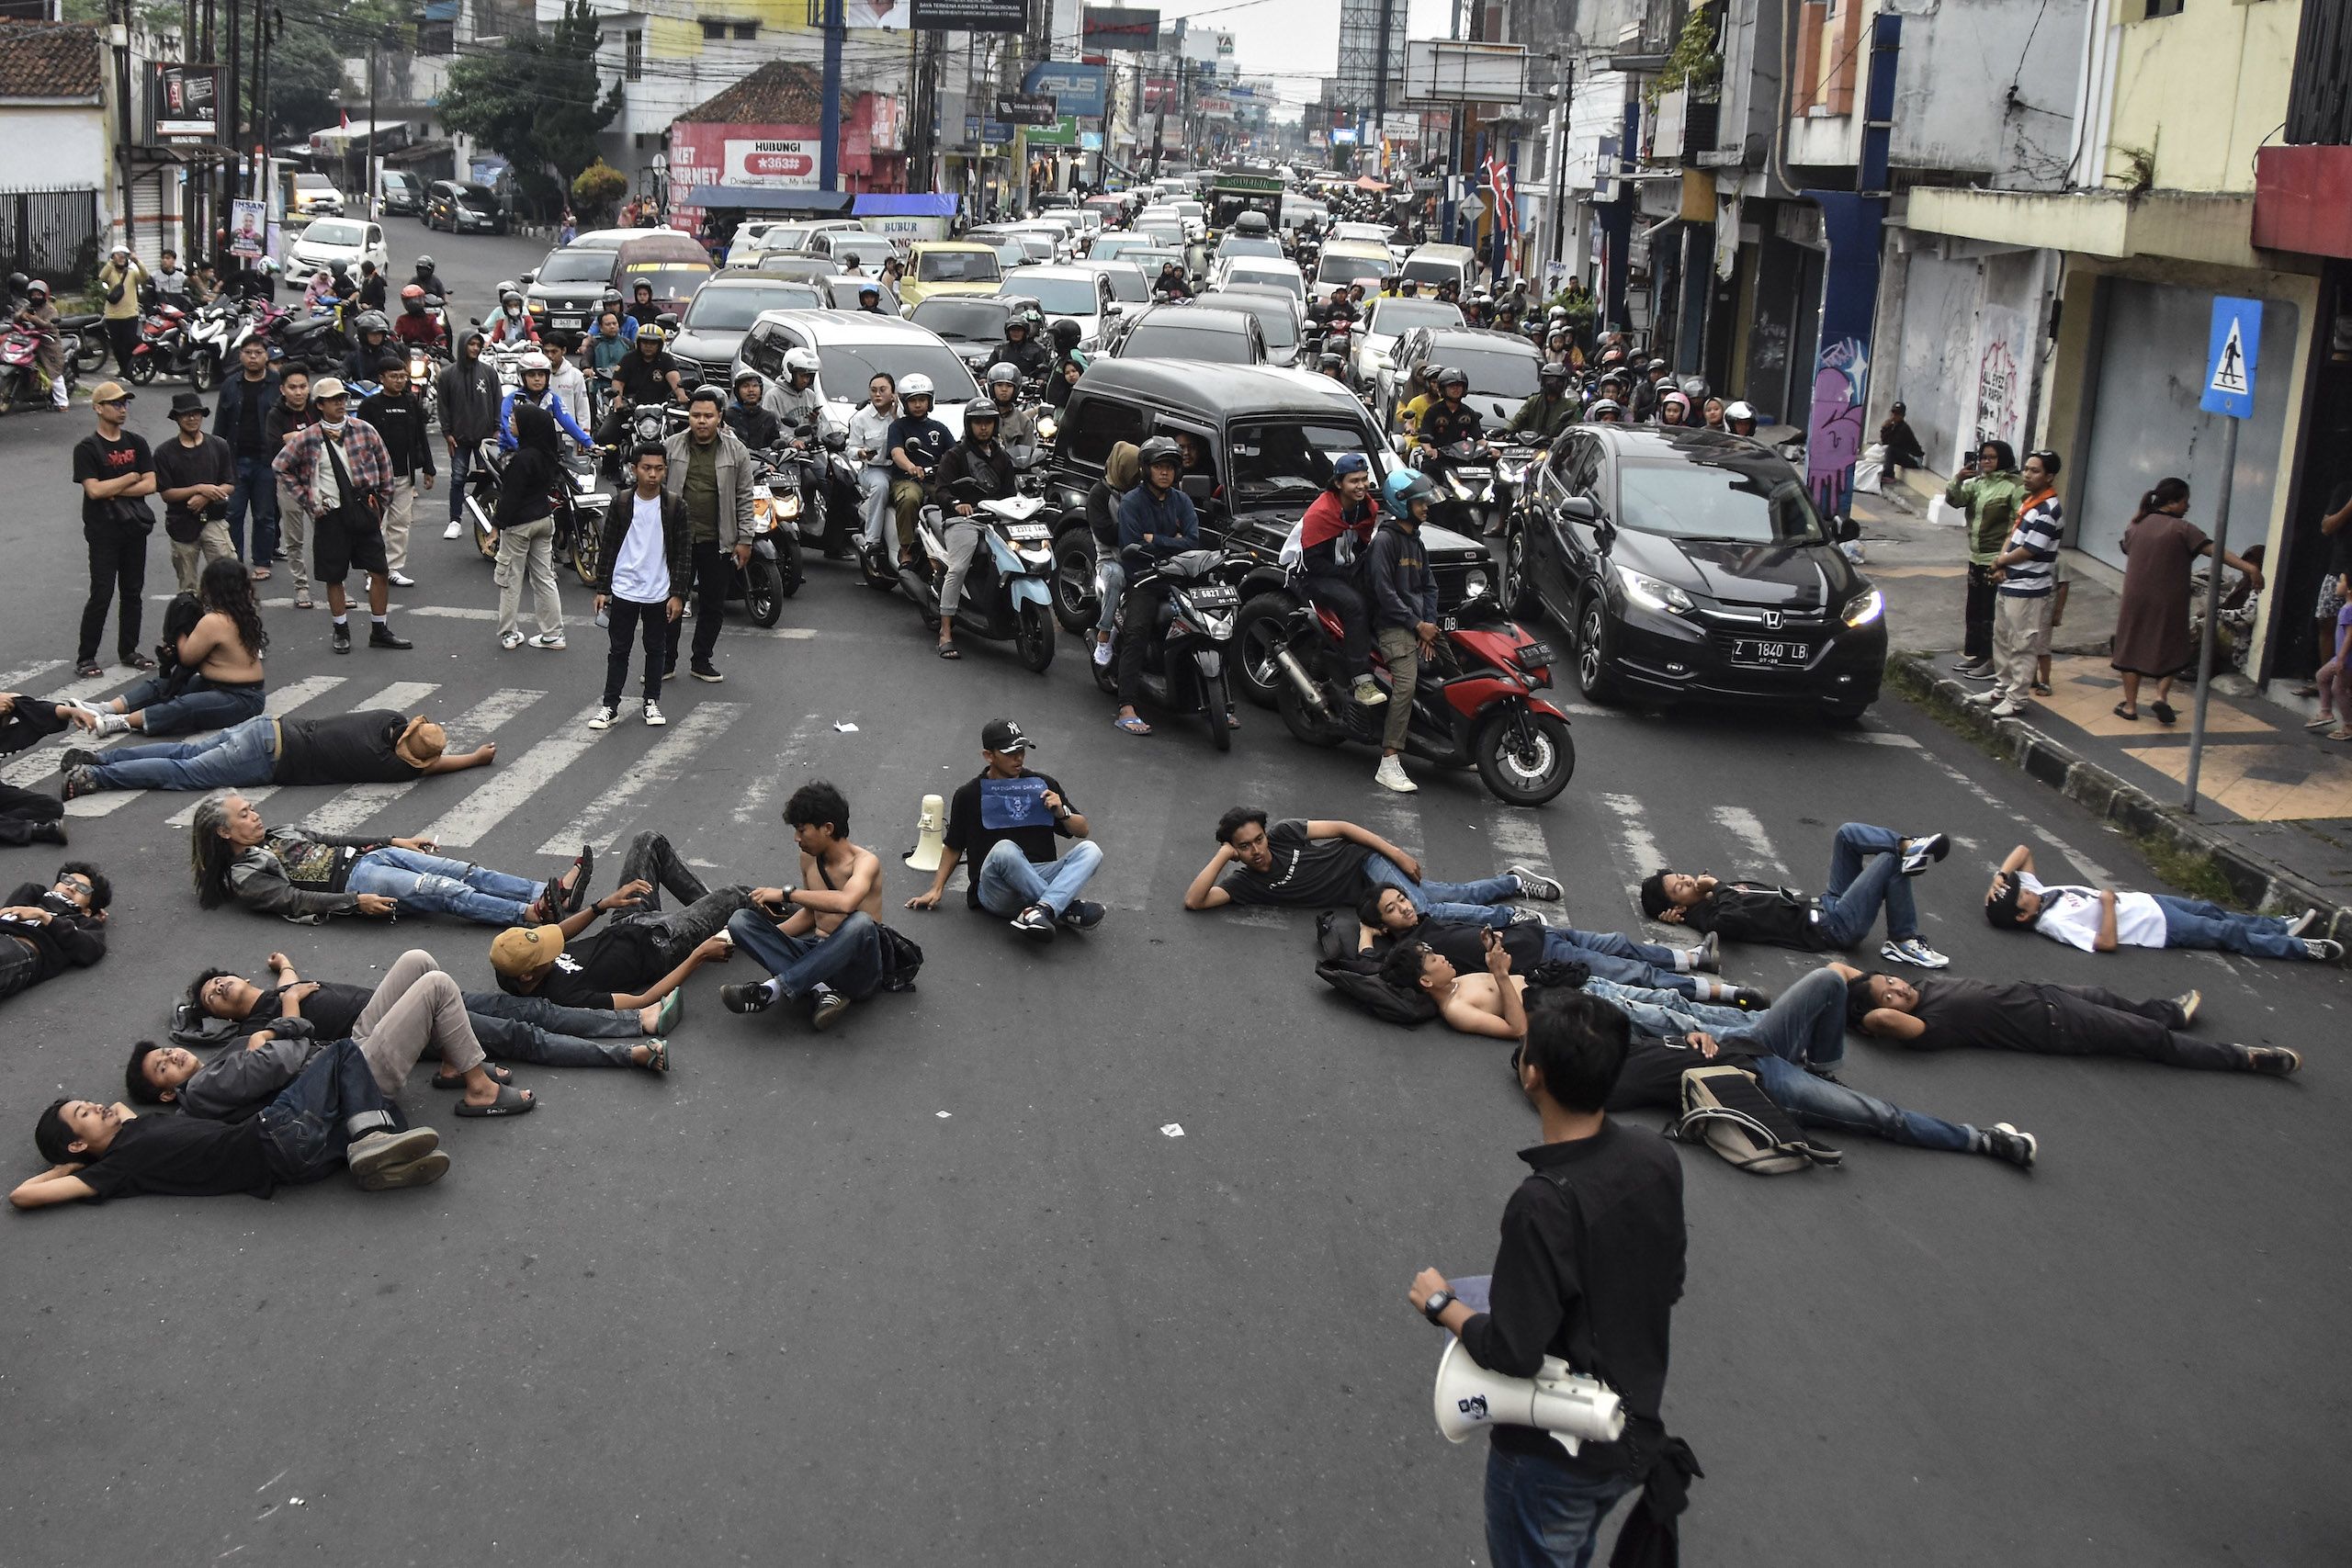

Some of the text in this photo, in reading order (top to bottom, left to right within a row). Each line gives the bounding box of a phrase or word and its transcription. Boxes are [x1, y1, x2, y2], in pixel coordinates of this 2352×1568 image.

[1035, 75, 1097, 93] ASUS
[755, 141, 801, 152] HUBUNGI
[234, 200, 265, 210] IHSAN
[884, 222, 918, 231] BUBUR
[1192, 591, 1199, 600] Z
[1201, 589, 1220, 598] 6827
[1735, 641, 1806, 660] Z 1840 LB
